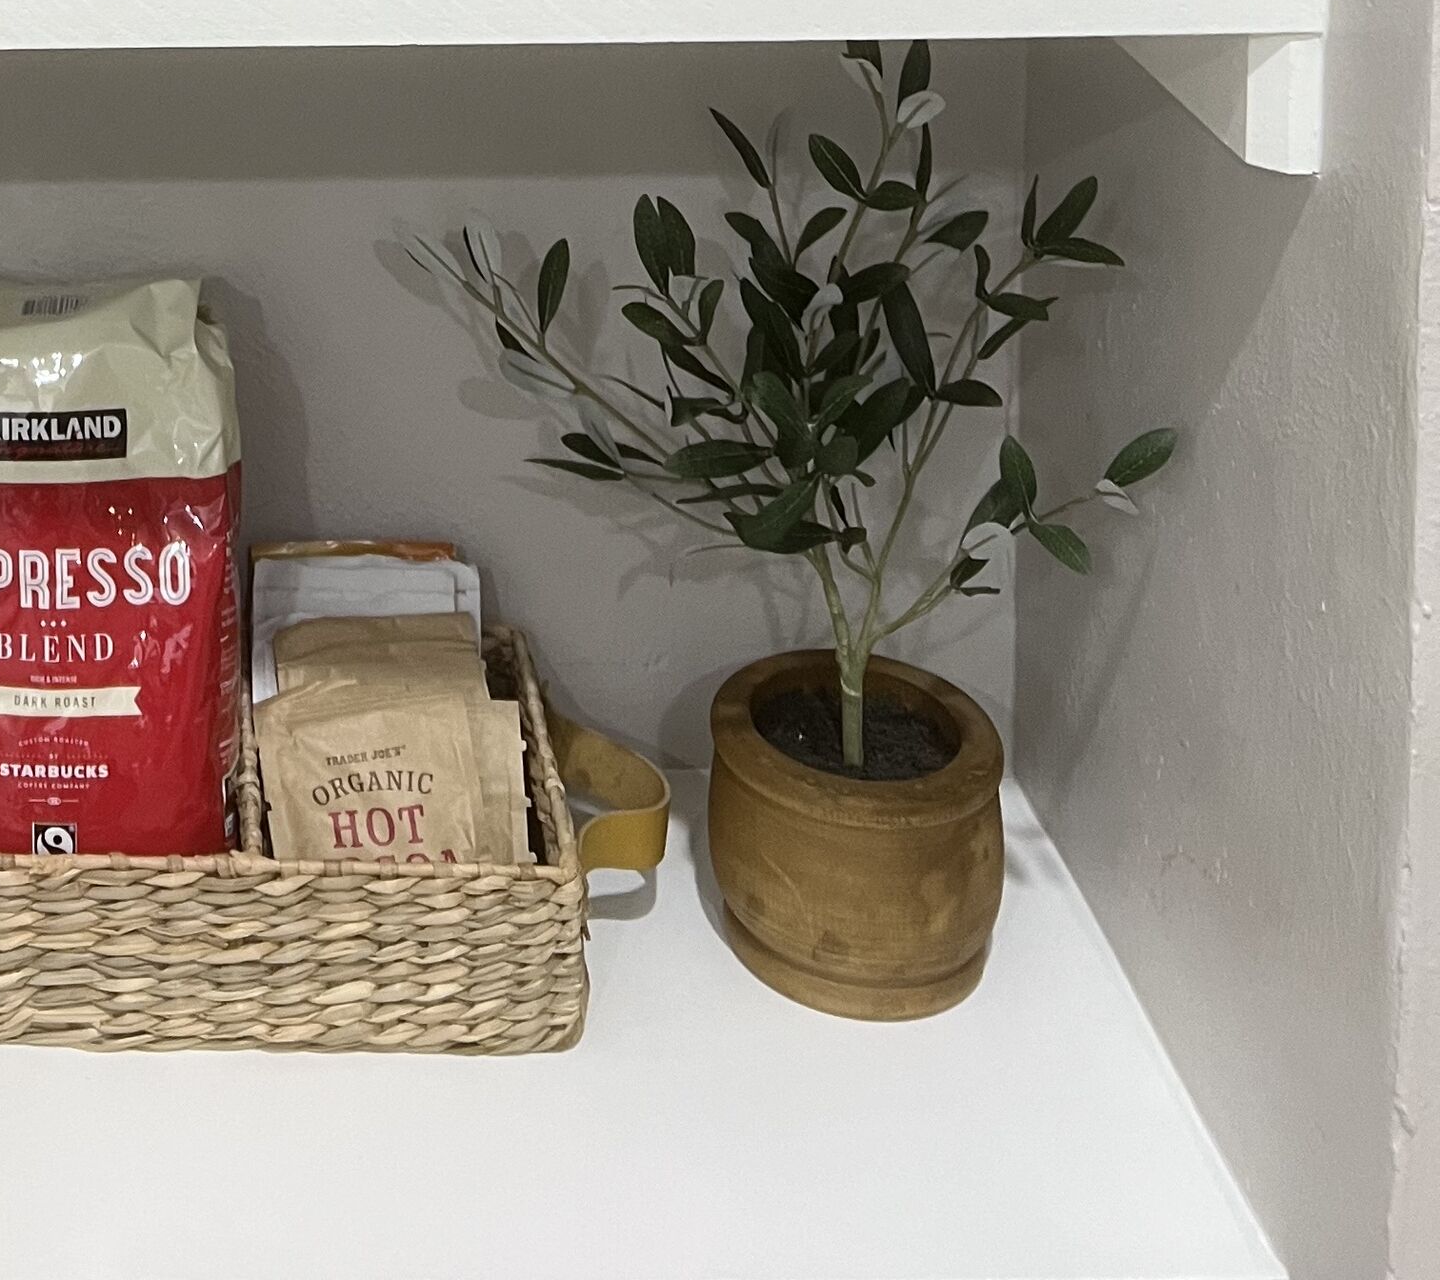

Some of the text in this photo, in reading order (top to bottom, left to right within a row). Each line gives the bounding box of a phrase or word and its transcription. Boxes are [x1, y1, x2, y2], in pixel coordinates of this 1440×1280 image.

[14, 695, 96, 708] DARK ROAST
[18, 736, 51, 747] CUSTOM
[326, 751, 368, 767] TRADER
[0, 763, 109, 779] STARBUCKS
[312, 771, 433, 806] ORGANIC
[328, 804, 424, 849] HOT
